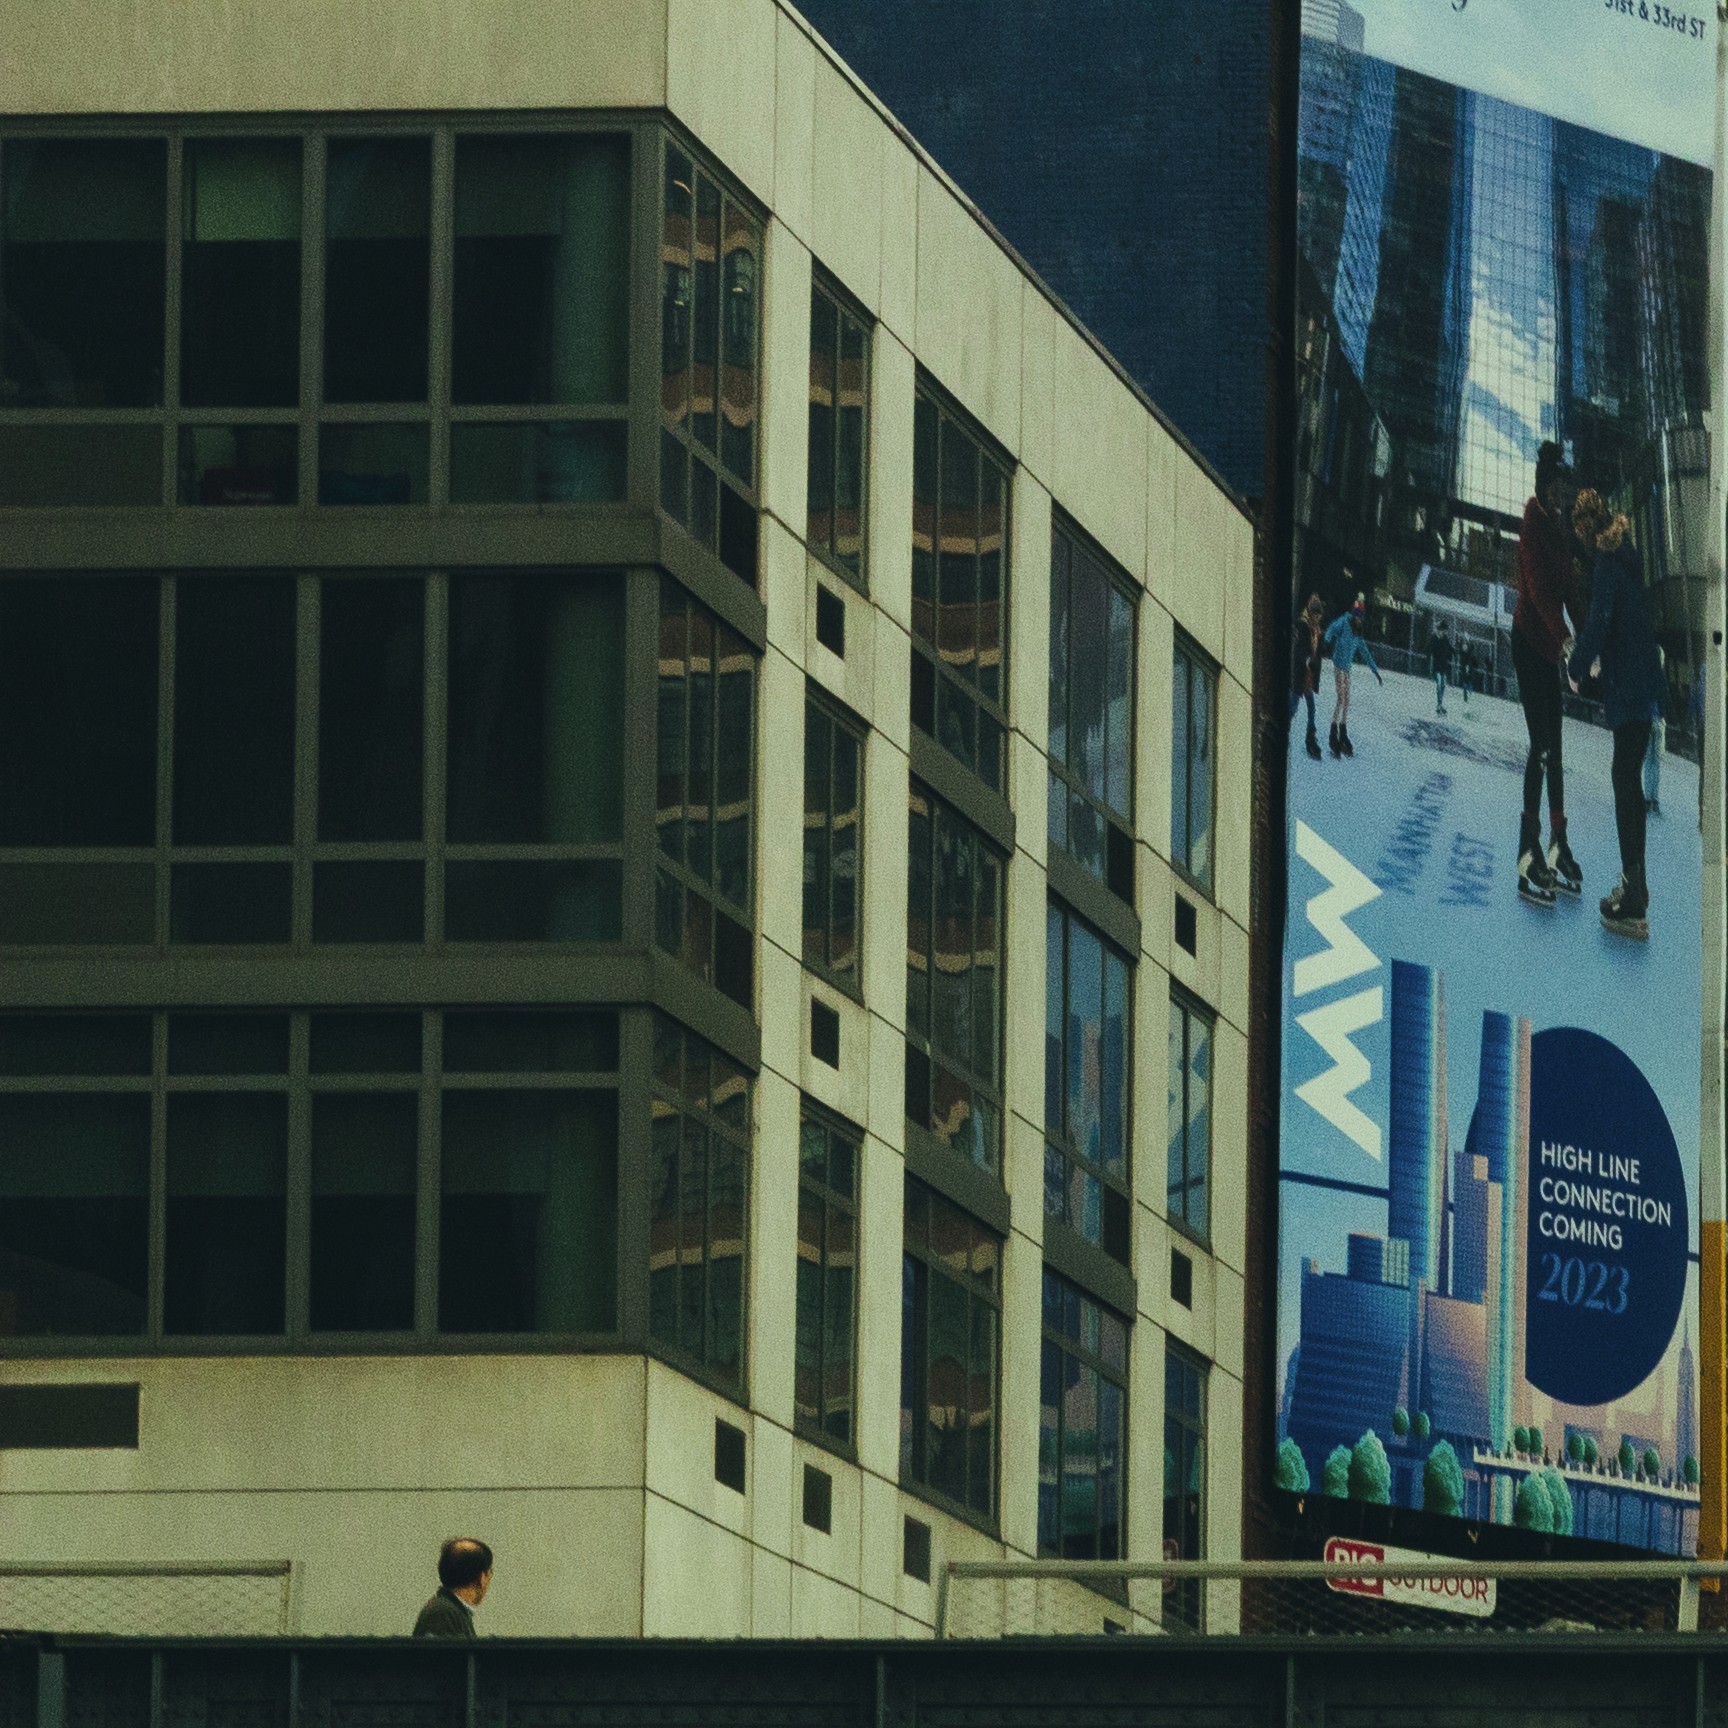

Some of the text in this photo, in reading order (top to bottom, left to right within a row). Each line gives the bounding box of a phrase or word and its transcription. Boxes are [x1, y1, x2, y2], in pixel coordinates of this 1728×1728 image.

[1654, 3, 1685, 33] 33rd
[1690, 17, 1706, 39] ST
[1541, 1140, 1640, 1184] HIGH LINE
[1539, 1176, 1671, 1228] CONNECTION
[1539, 1211, 1623, 1250] COMING
[1537, 1252, 1630, 1314] 2023
[1388, 1565, 1488, 1604] DOOR
